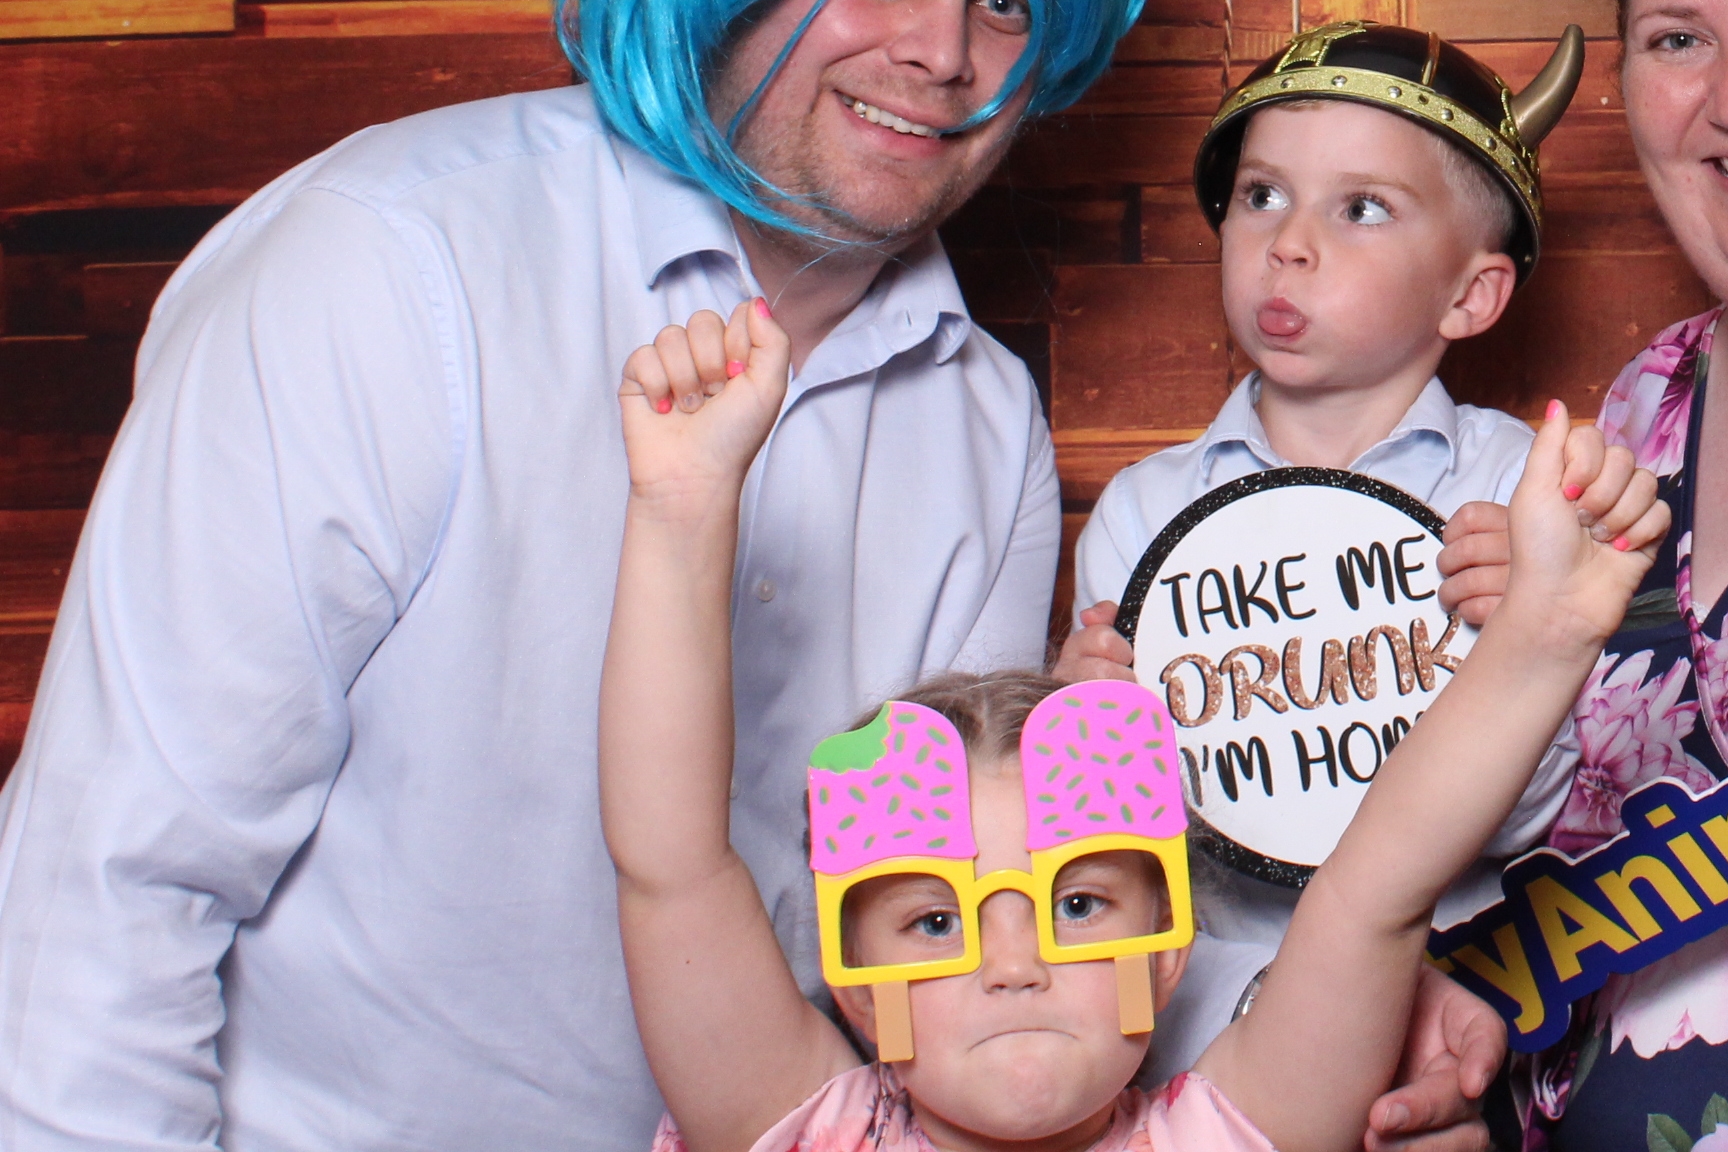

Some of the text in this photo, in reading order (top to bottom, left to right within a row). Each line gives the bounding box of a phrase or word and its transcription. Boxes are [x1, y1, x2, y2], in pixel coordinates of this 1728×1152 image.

[1160, 533, 1437, 638] TAKE ME
[1159, 613, 1466, 728] DRUNK
[1179, 735, 1275, 808] I'M
